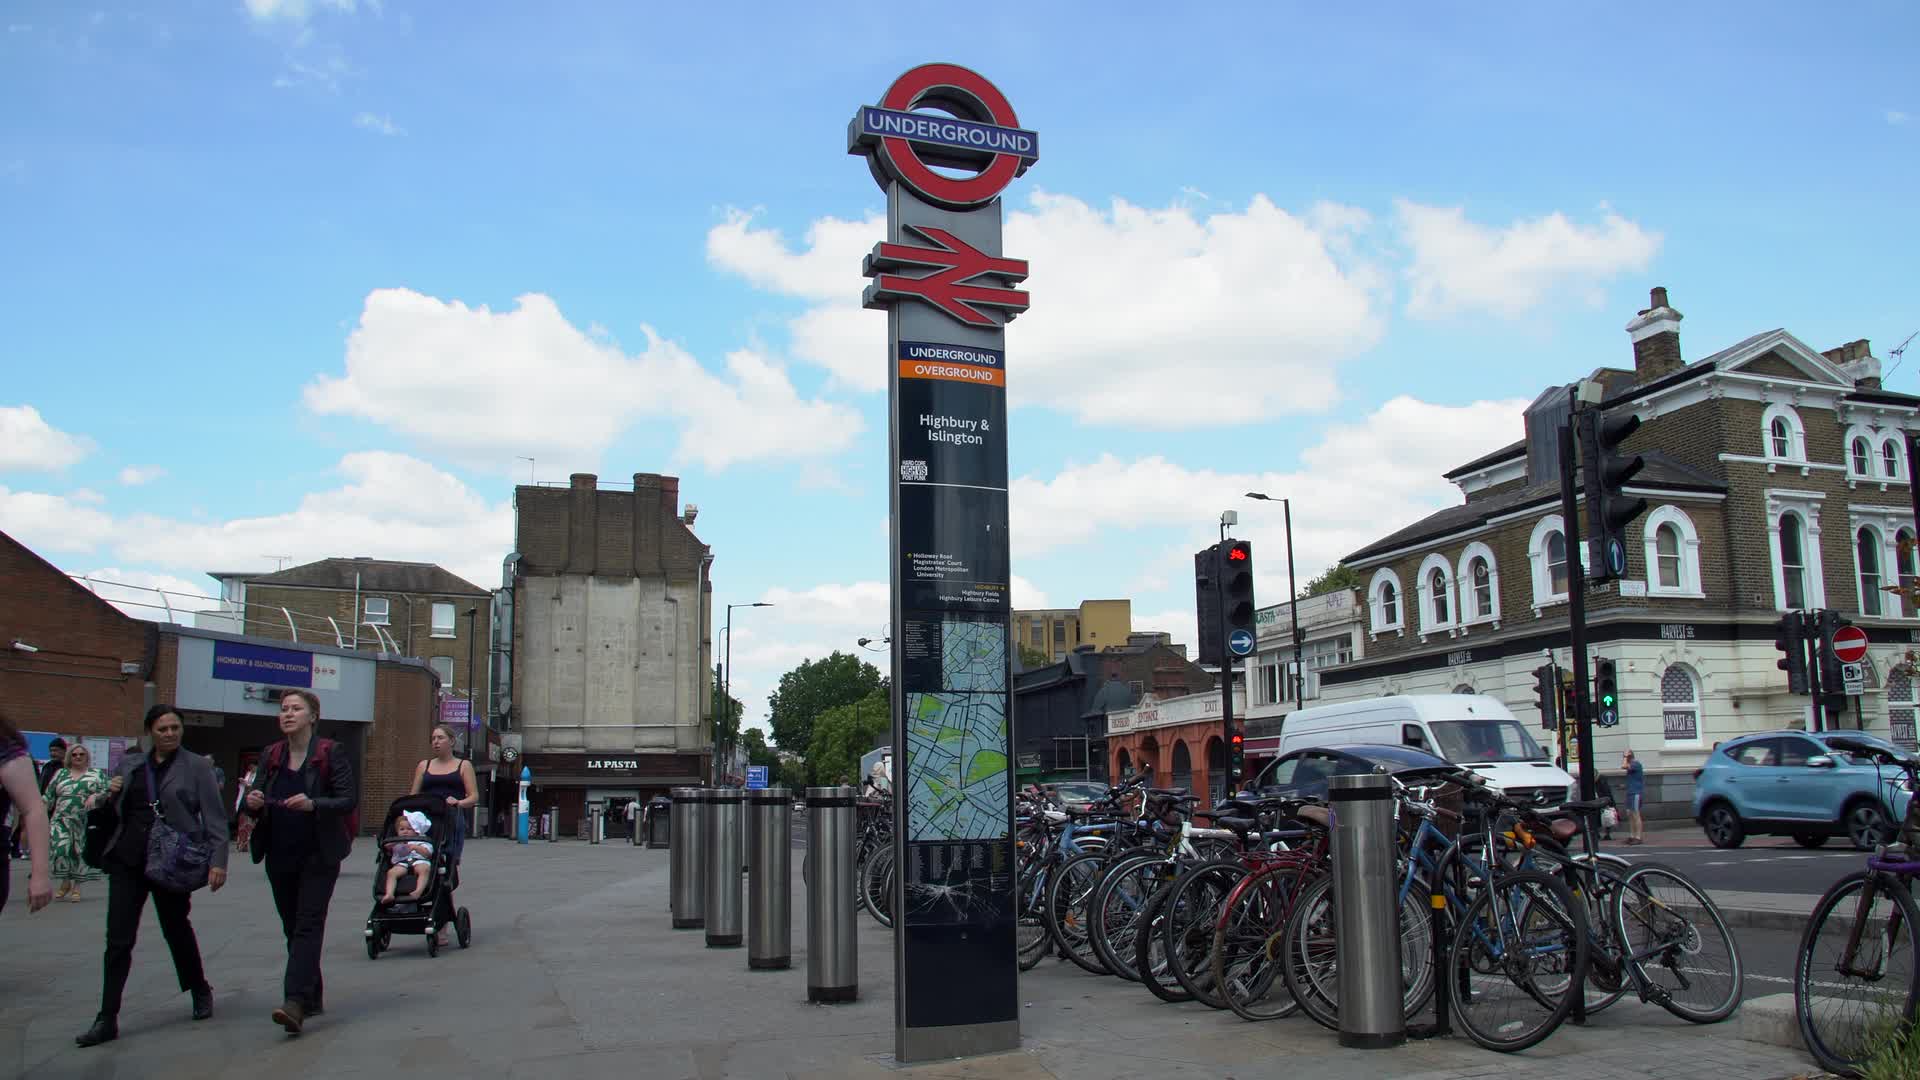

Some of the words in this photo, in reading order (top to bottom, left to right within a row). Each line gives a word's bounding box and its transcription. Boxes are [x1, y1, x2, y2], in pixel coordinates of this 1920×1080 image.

[868, 111, 1032, 153] UNDERGROUND
[910, 347, 996, 365] UNDERGROUND
[914, 365, 993, 381] OVERGROUND
[920, 414, 977, 431] Highbury
[981, 419, 990, 431] &
[928, 430, 983, 445] Islington
[286, 664, 309, 673] STATION
[587, 760, 602, 769] LA
[603, 760, 638, 769] PASTA
